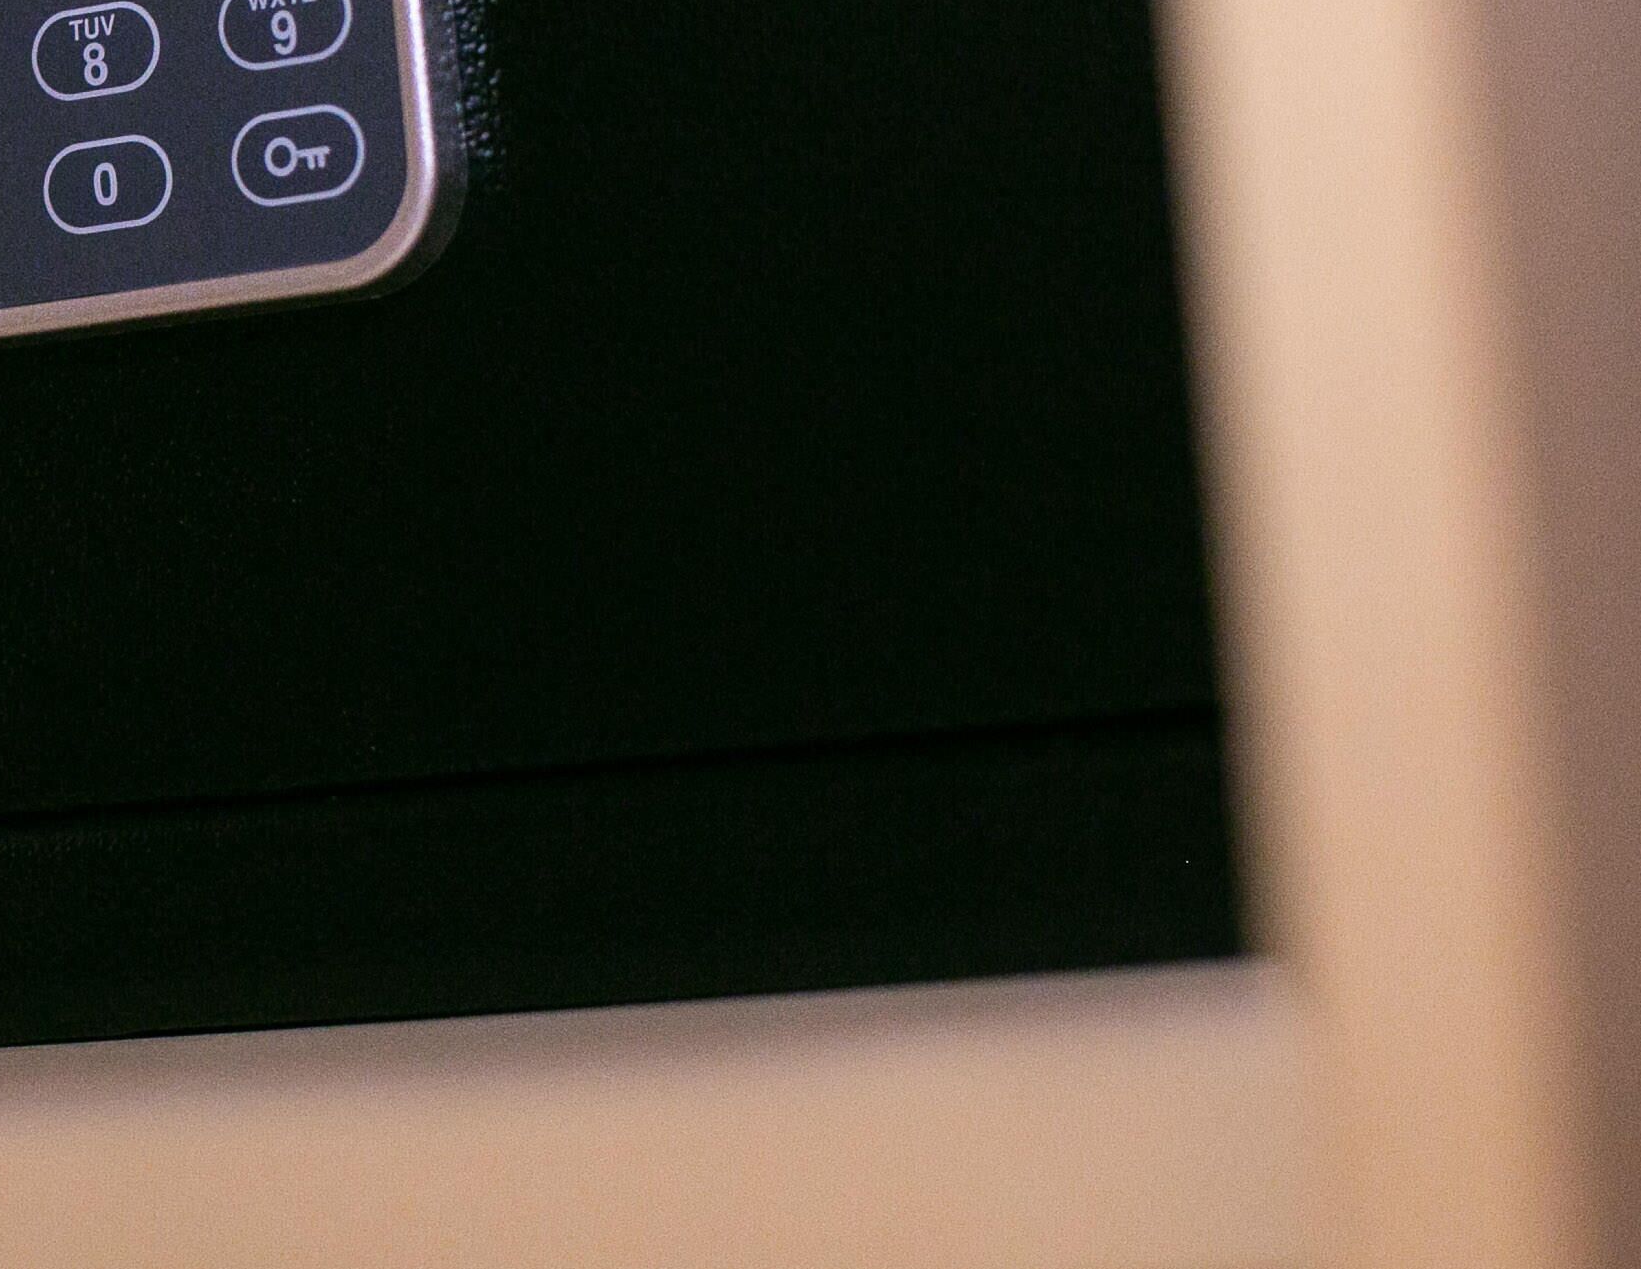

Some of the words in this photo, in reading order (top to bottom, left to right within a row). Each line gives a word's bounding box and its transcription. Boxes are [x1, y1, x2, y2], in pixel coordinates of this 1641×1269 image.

[68, 14, 115, 42] TUV
[271, 10, 297, 57] 9
[83, 43, 108, 88] 8
[94, 163, 117, 205] 0
